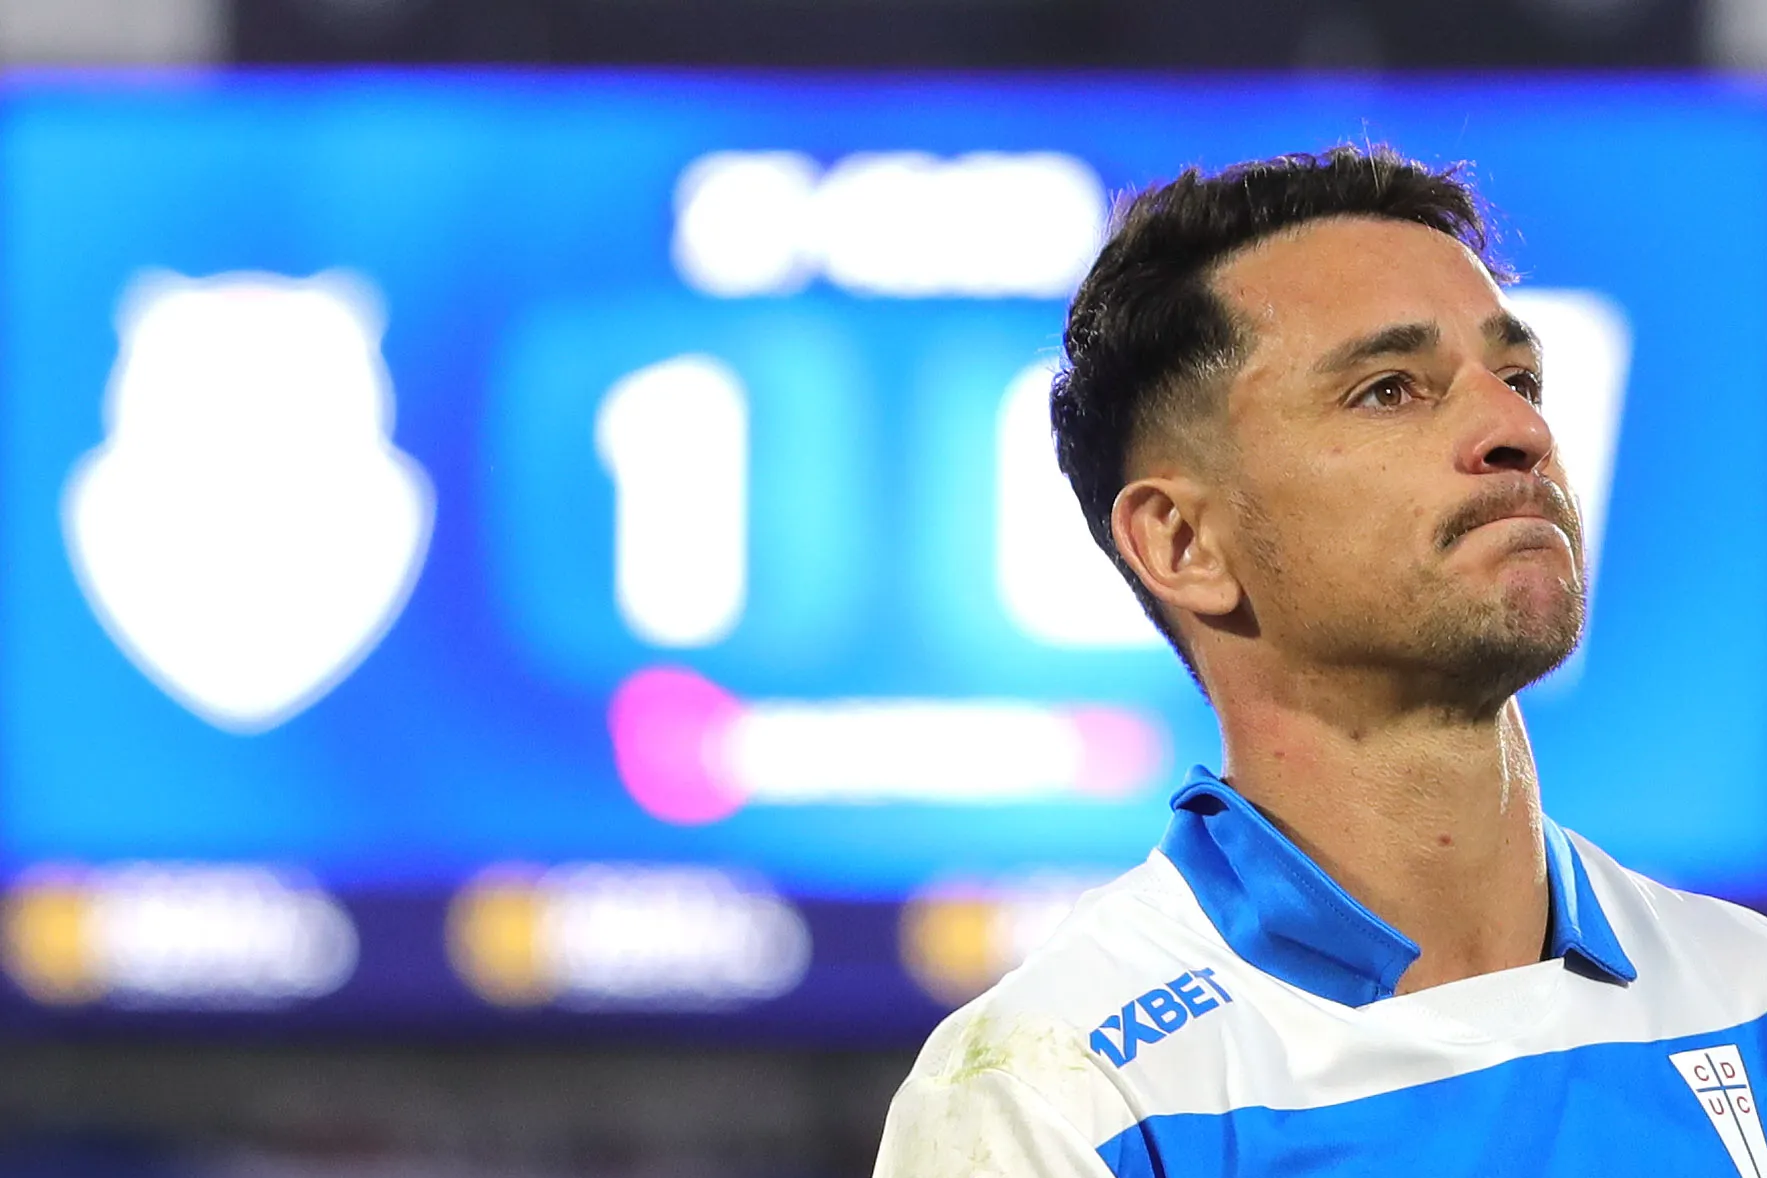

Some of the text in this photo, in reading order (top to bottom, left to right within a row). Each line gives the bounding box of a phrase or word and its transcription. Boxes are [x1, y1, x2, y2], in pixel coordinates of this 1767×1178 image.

[597, 353, 749, 646] 1
[1089, 967, 1233, 1069] 1XBET
[1694, 1062, 1736, 1082] C D
[1709, 1096, 1750, 1115] U C
